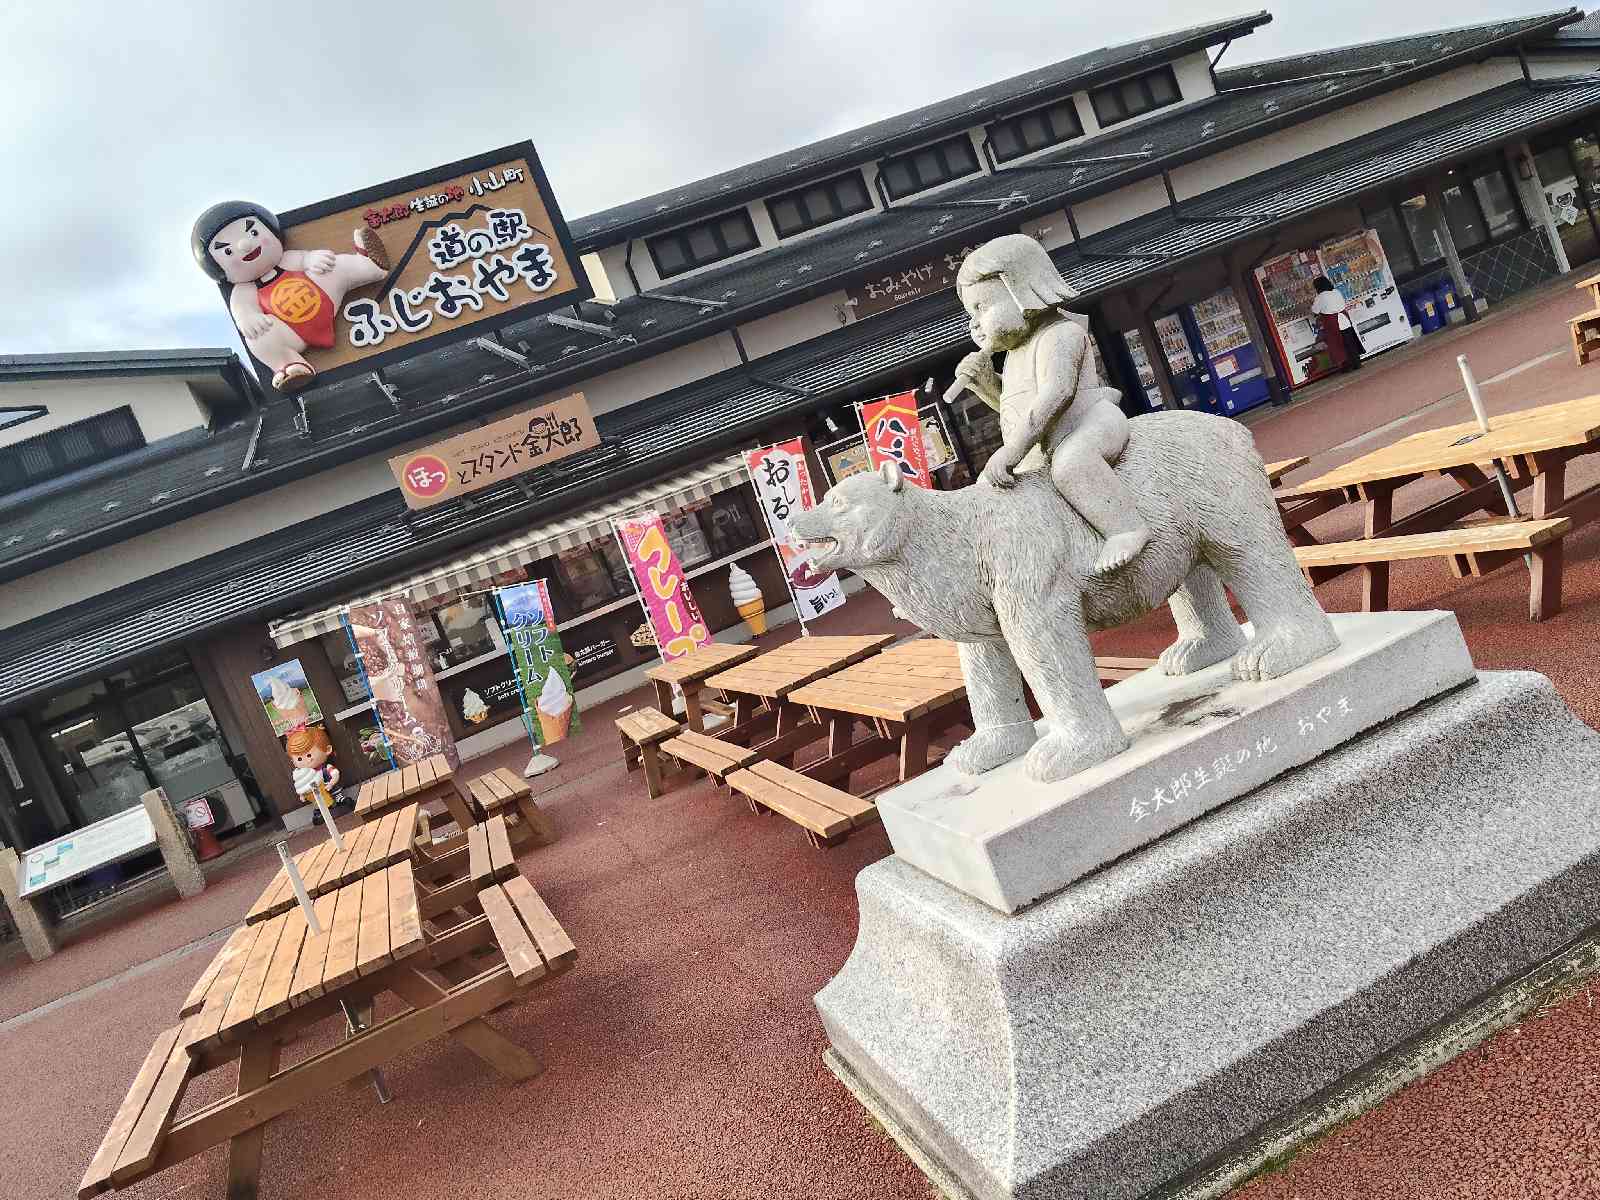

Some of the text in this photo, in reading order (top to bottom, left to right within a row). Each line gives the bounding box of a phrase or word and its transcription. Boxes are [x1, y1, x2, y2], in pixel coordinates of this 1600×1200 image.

[467, 166, 525, 198] 小山町
[431, 208, 530, 266] 道の駅
[346, 244, 557, 346] ふじおやま
[512, 611, 544, 685] クリーム
[528, 610, 554, 663] ソフト
[1129, 694, 1353, 822] 金太郎生誕の地 おやま
